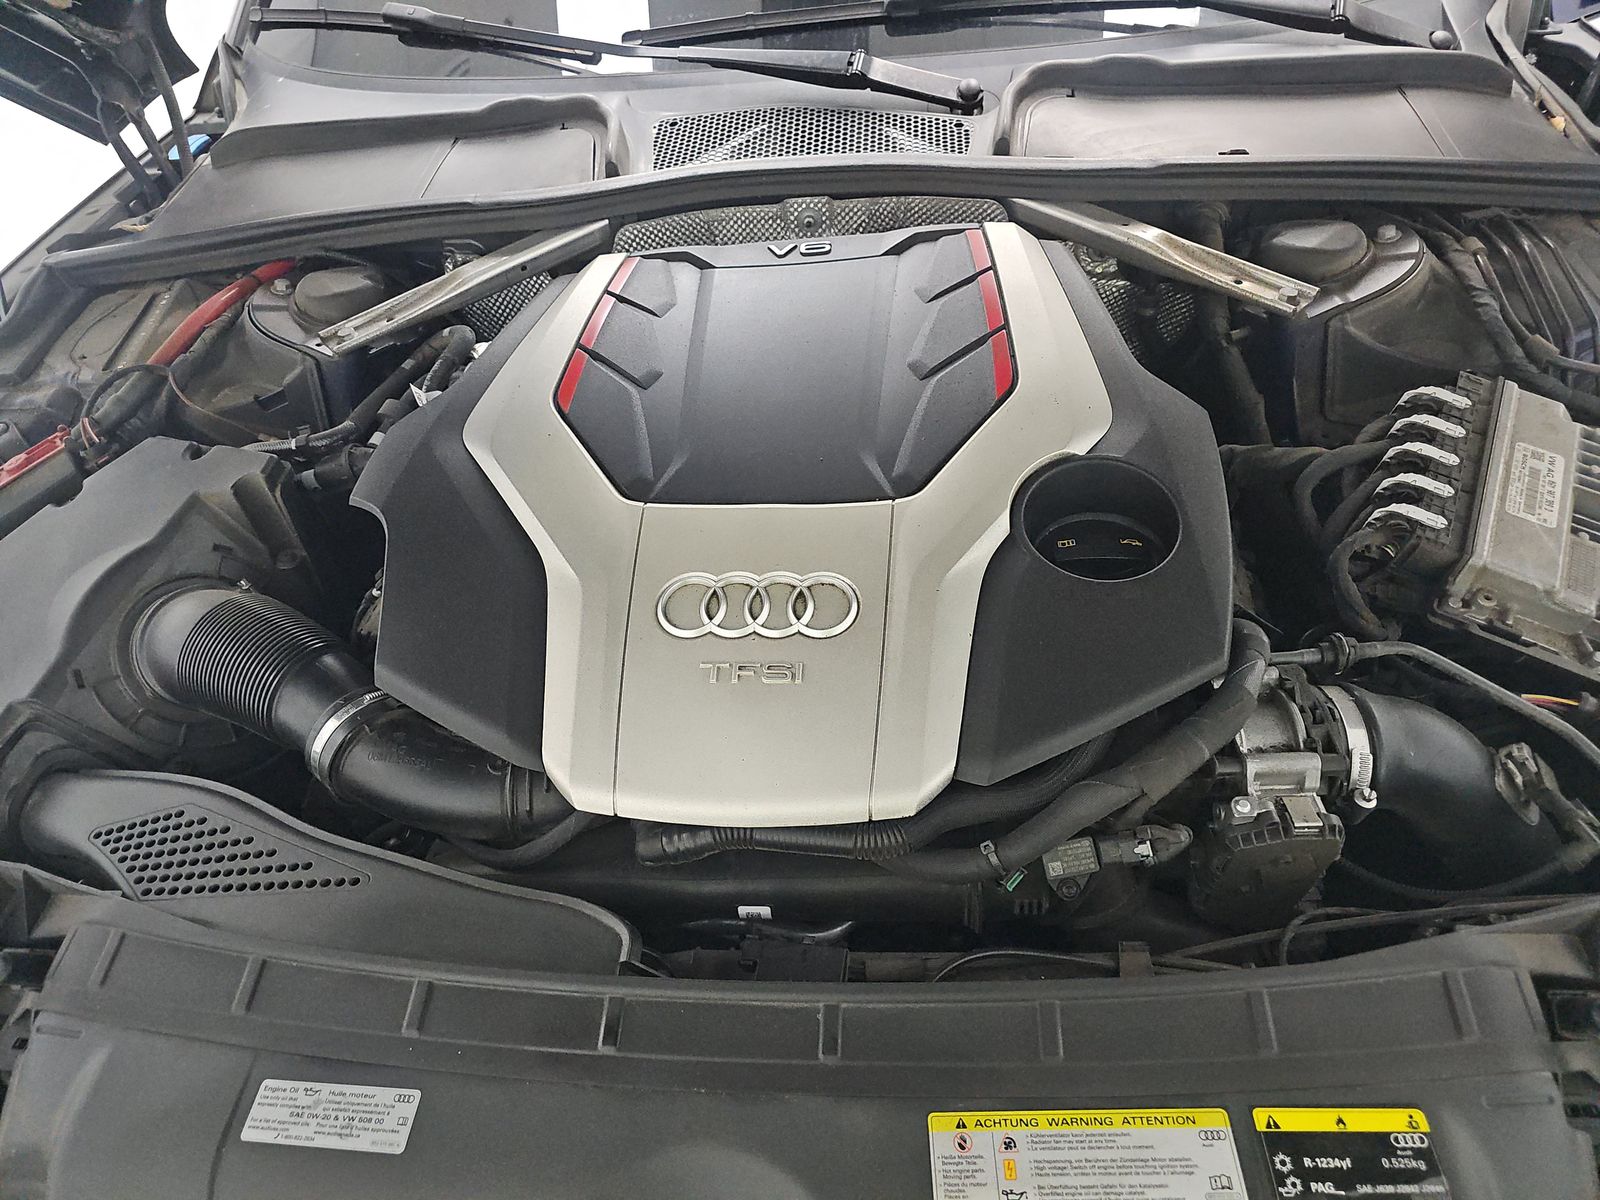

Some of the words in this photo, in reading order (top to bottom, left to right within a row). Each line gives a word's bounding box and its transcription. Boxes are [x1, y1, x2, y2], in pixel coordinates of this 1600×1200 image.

[767, 241, 832, 259] V6
[699, 663, 803, 683] TFSI
[264, 1085, 287, 1093] Engine
[328, 1089, 347, 1097] Huile
[348, 1091, 376, 1099] moteur
[974, 1118, 1039, 1128] ACHTUNG
[1046, 1116, 1114, 1127] WARNING
[1121, 1115, 1196, 1126] ATTENTION
[1303, 1157, 1352, 1170] R-1234yf
[1381, 1157, 1427, 1171] 0.525kg
